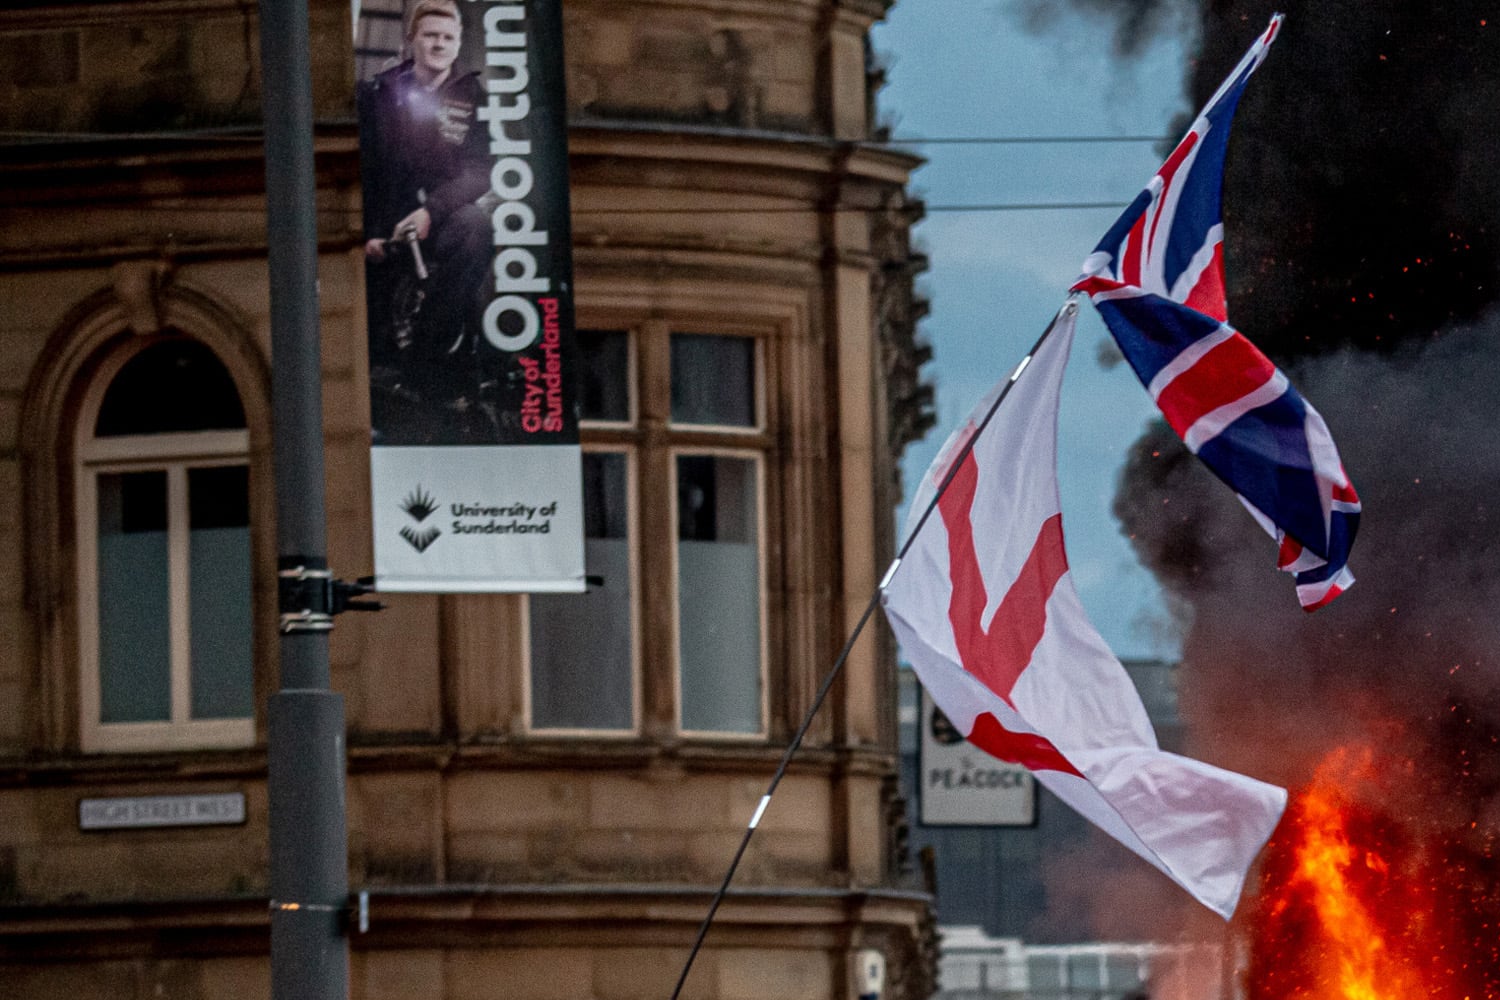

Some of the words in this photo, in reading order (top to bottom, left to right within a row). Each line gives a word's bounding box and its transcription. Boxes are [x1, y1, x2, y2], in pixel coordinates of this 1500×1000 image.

[478, 0, 550, 352] Opportun
[518, 357, 540, 381] of
[538, 297, 563, 432] Sunderland
[521, 382, 544, 433] City
[451, 502, 537, 520] University
[539, 501, 558, 517] of
[452, 519, 551, 535] Sunderland
[930, 768, 1023, 789] PEACOCK
